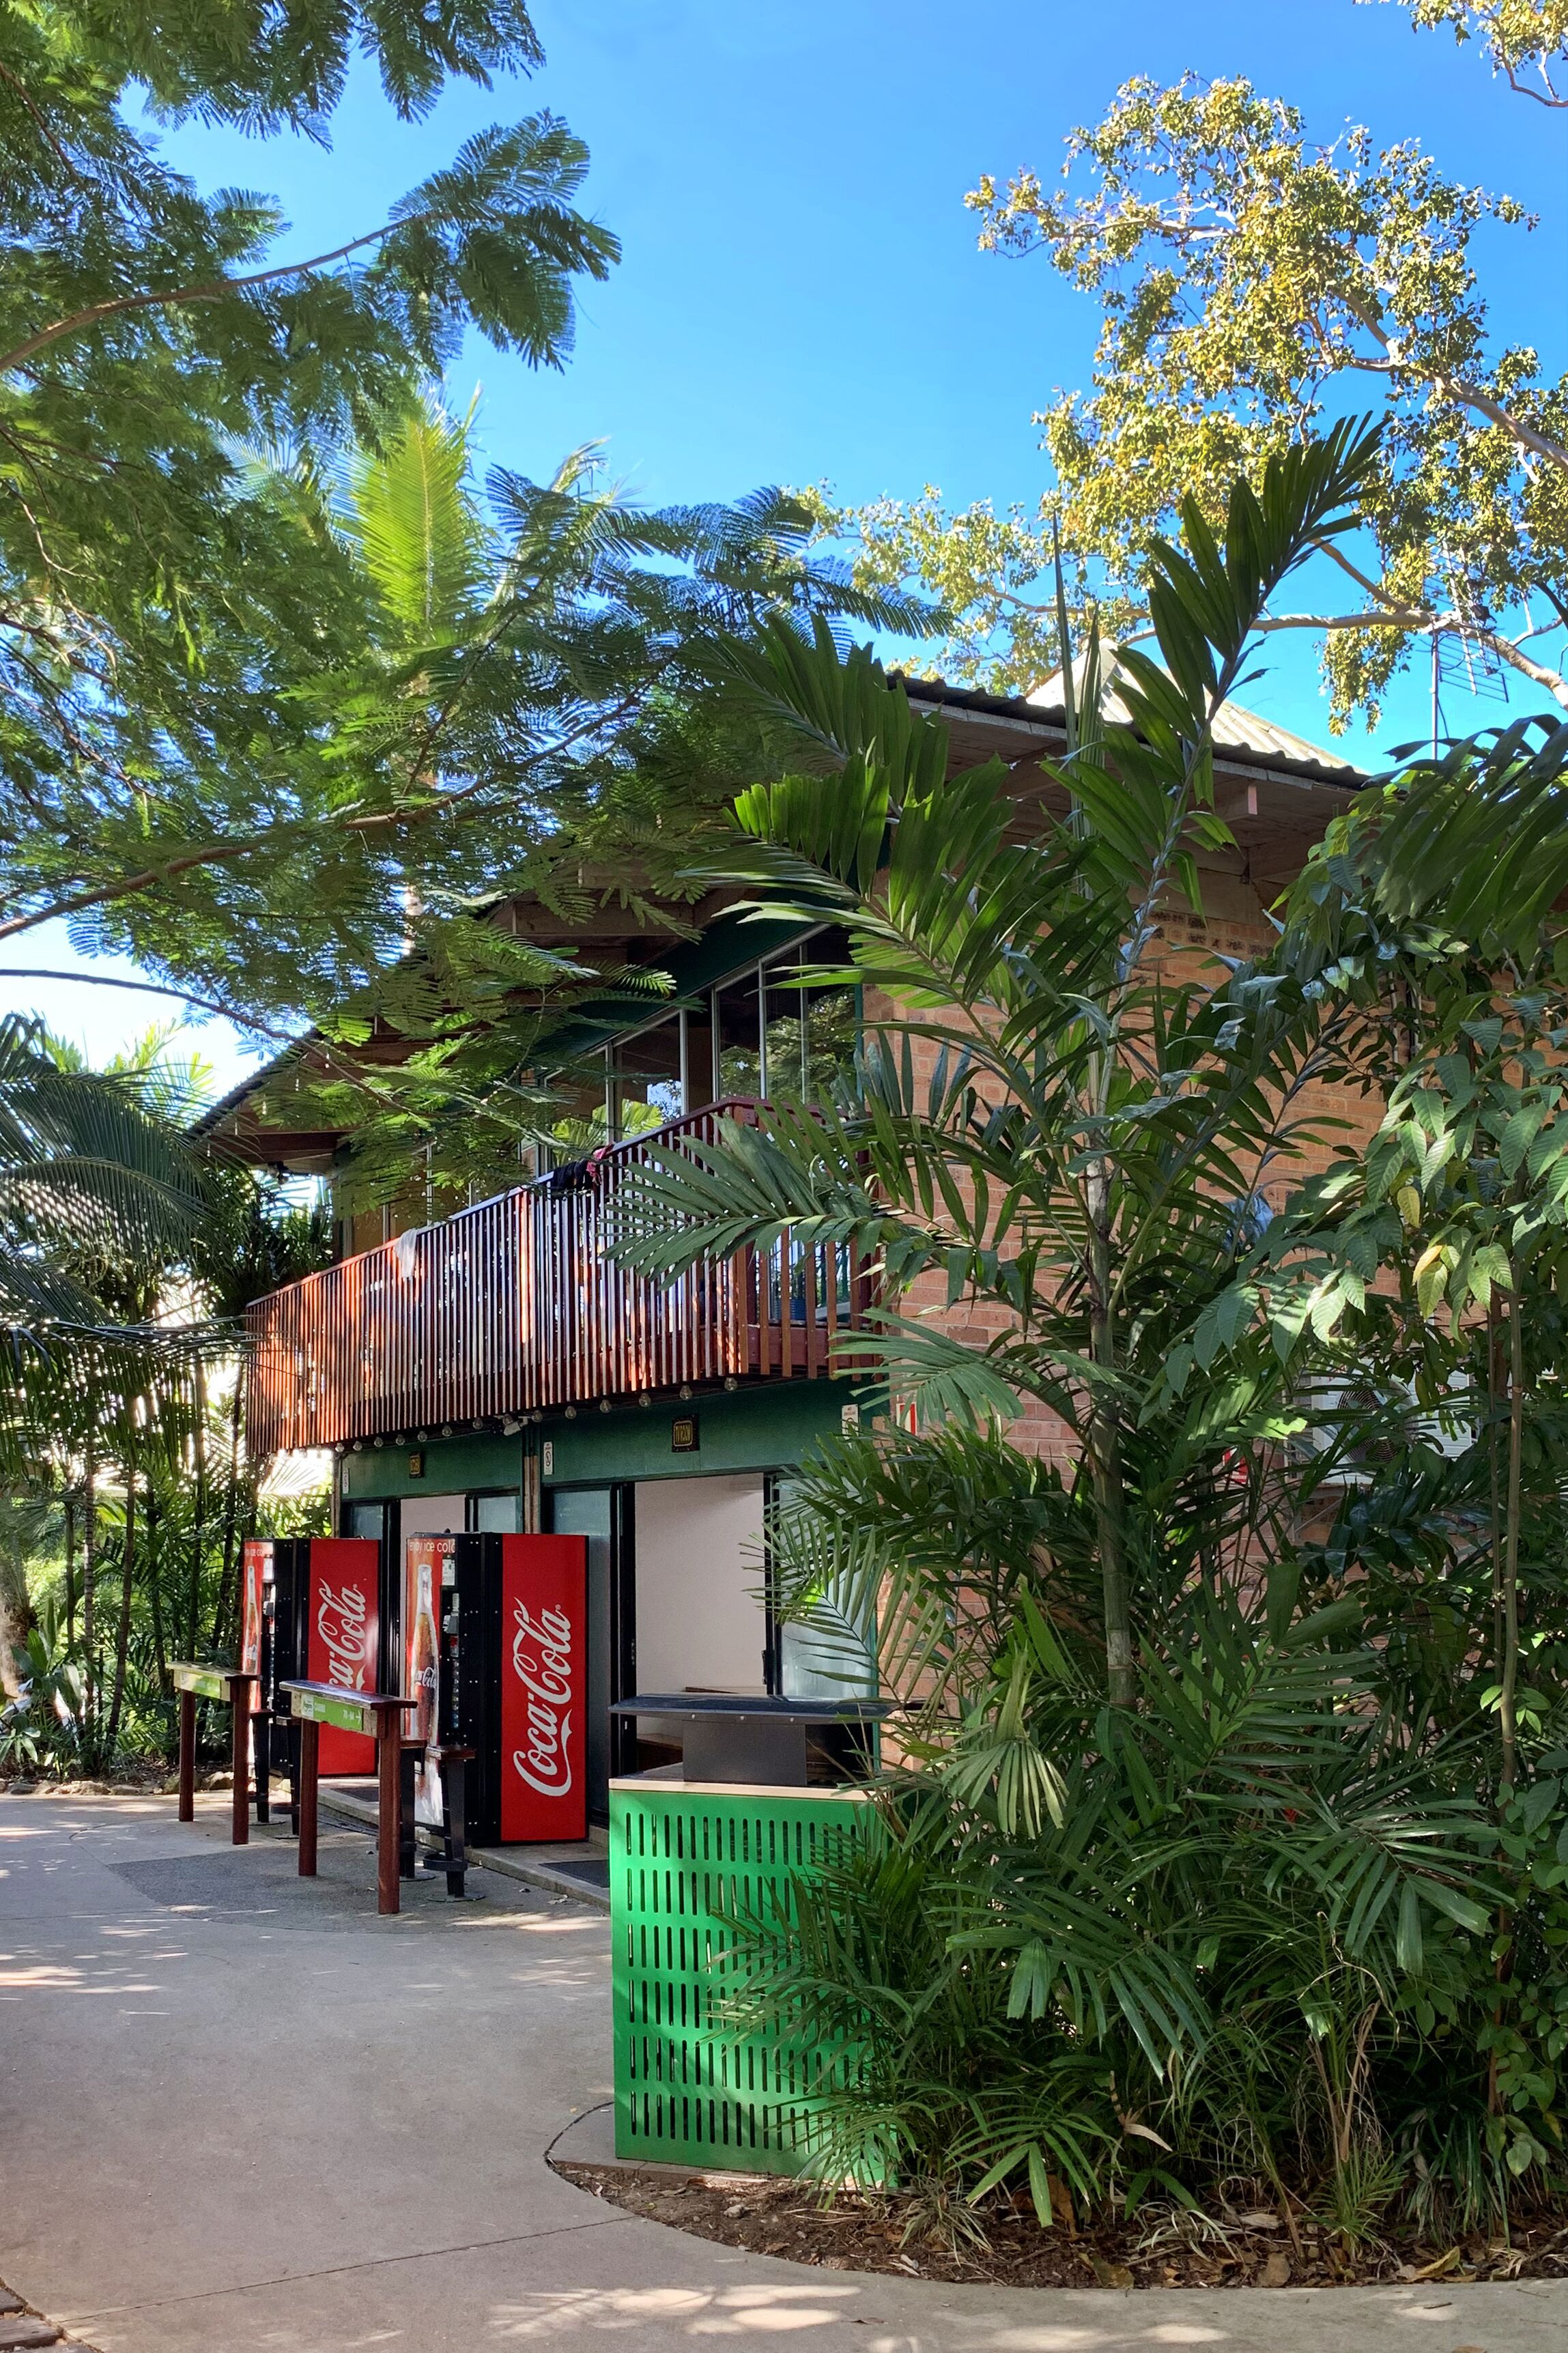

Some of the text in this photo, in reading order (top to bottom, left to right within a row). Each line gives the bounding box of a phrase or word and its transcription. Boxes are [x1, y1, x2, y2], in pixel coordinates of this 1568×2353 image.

[424, 1539, 435, 1552] ice
[318, 1578, 366, 1689] a-Cola
[513, 1597, 572, 1797] Coca-Cola
